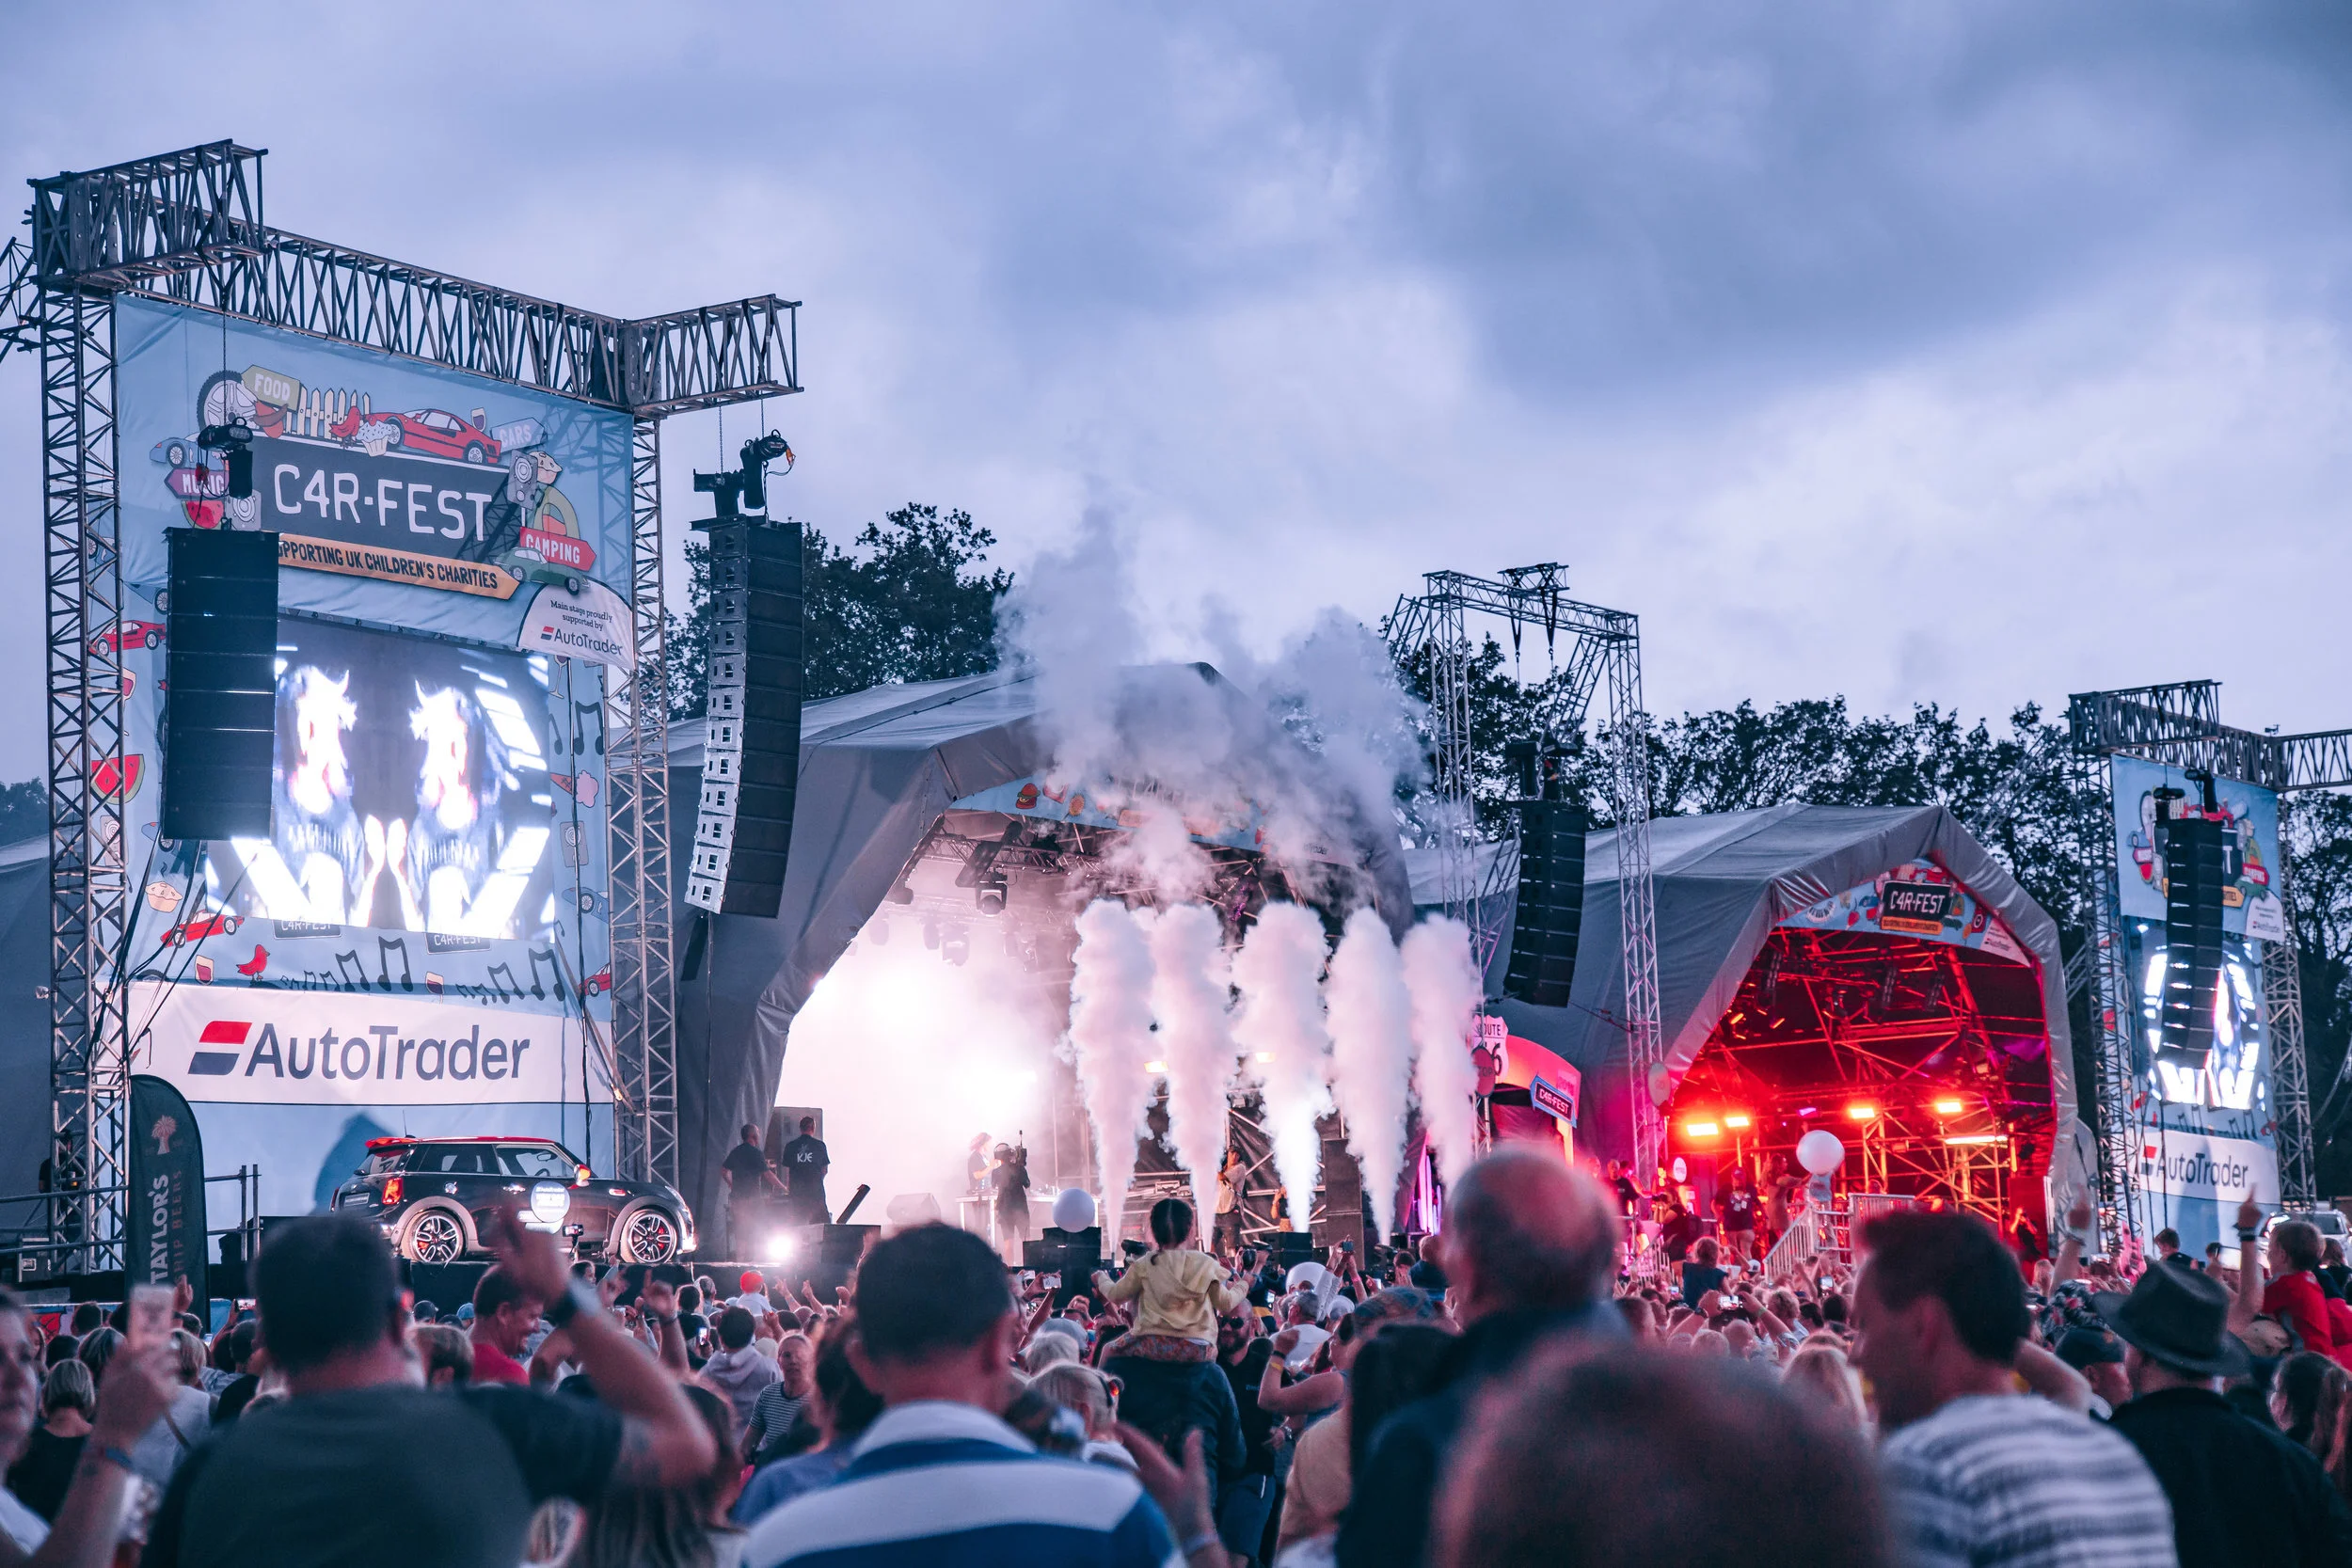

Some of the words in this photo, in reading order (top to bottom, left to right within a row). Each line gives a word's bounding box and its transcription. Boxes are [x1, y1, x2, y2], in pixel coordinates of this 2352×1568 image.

[254, 372, 291, 402] FOOD
[499, 424, 532, 449] CARS
[524, 533, 580, 564] CAMPING
[345, 550, 364, 569] UK
[364, 553, 436, 579] CHILDREN'S
[437, 564, 498, 590] CHARITIES
[550, 600, 568, 611] Main
[569, 605, 585, 616] stage
[586, 610, 612, 623] proudly
[563, 614, 594, 628] supported
[595, 620, 603, 631] by
[554, 628, 623, 656] AutoTrader
[244, 1022, 530, 1081] AutoTrader
[2156, 1152, 2249, 1188] AutoTrader
[172, 1169, 183, 1229] BEERS
[147, 1174, 169, 1286] TAYLOR'S
